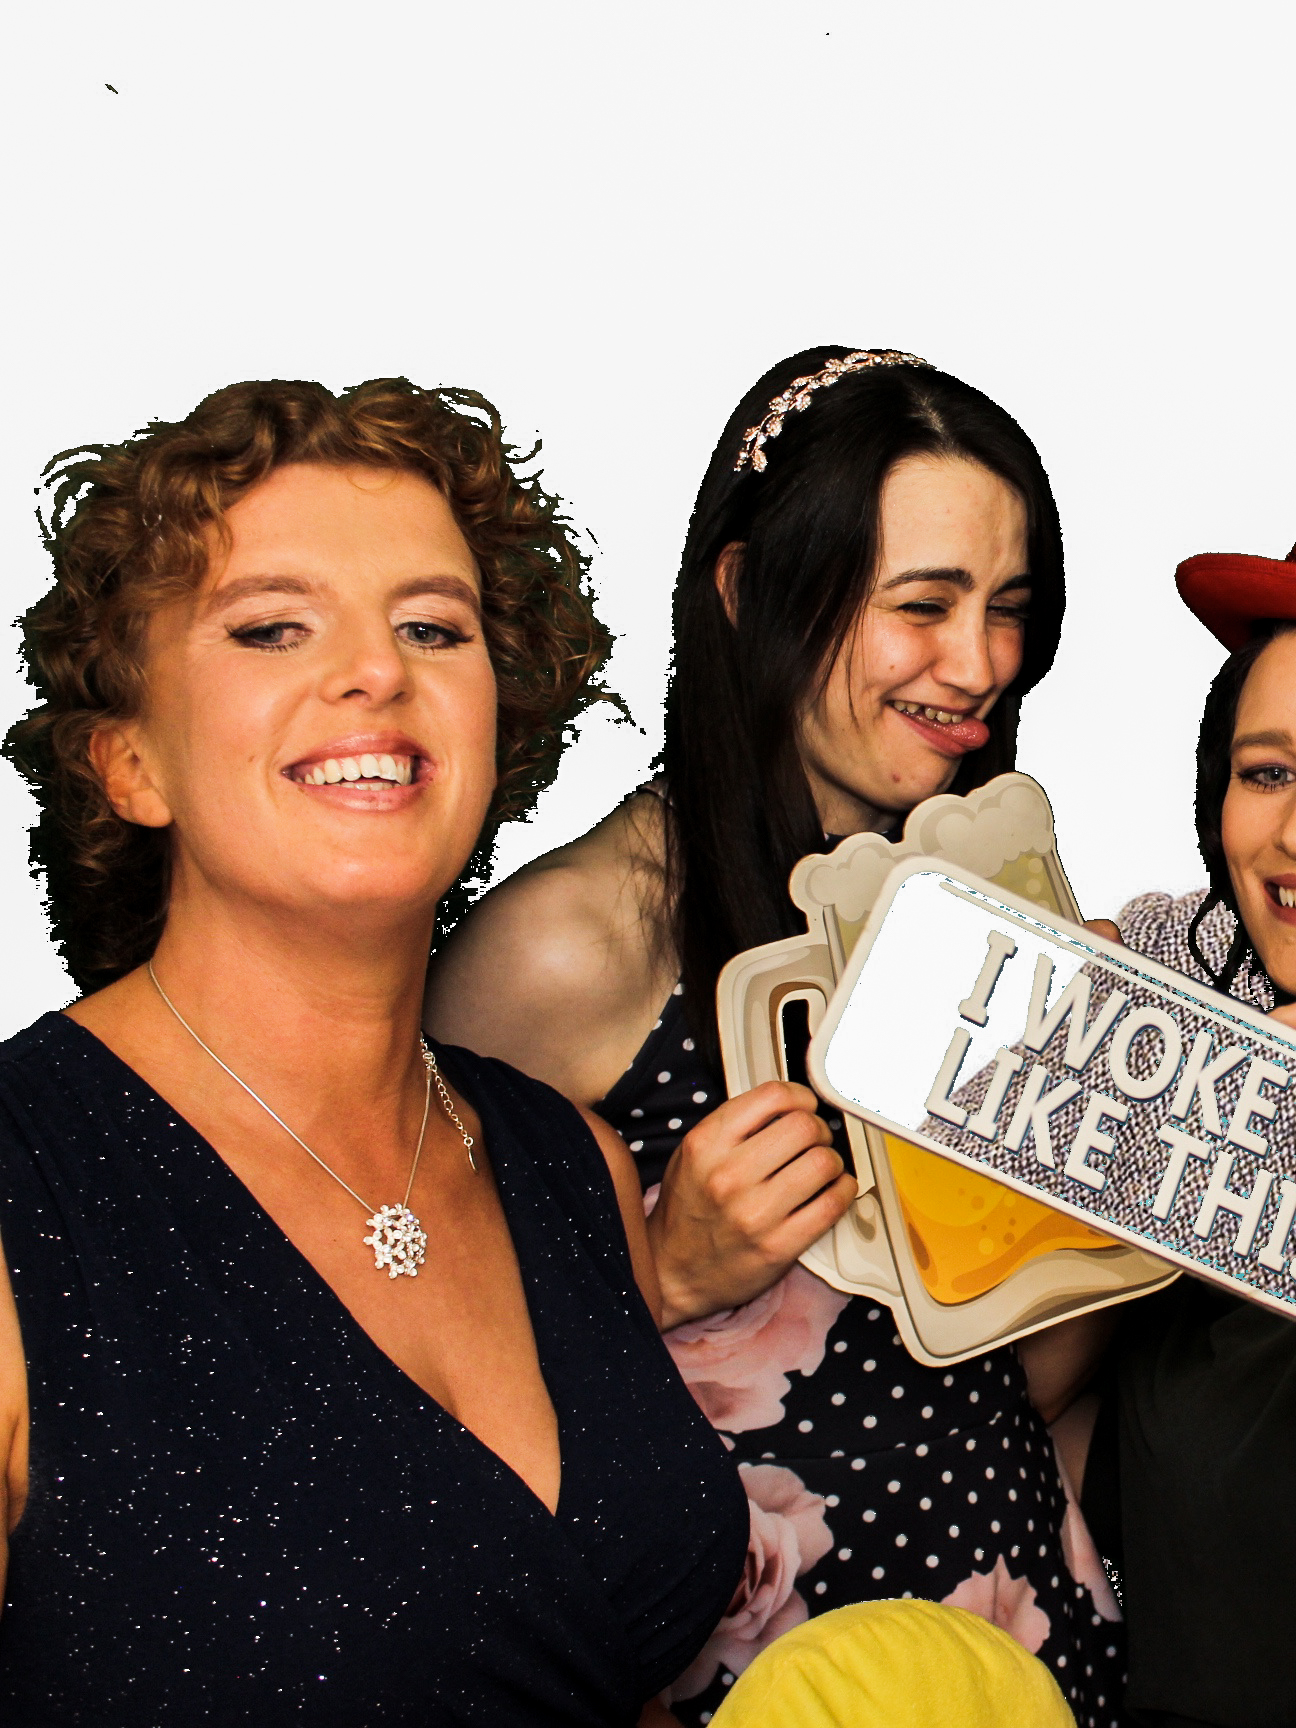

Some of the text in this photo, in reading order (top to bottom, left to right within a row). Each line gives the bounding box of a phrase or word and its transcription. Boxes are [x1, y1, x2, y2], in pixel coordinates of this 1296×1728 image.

[926, 1027, 1129, 1191] LIKE
[957, 930, 1016, 1026] I
[1024, 953, 1289, 1156] WOKE
